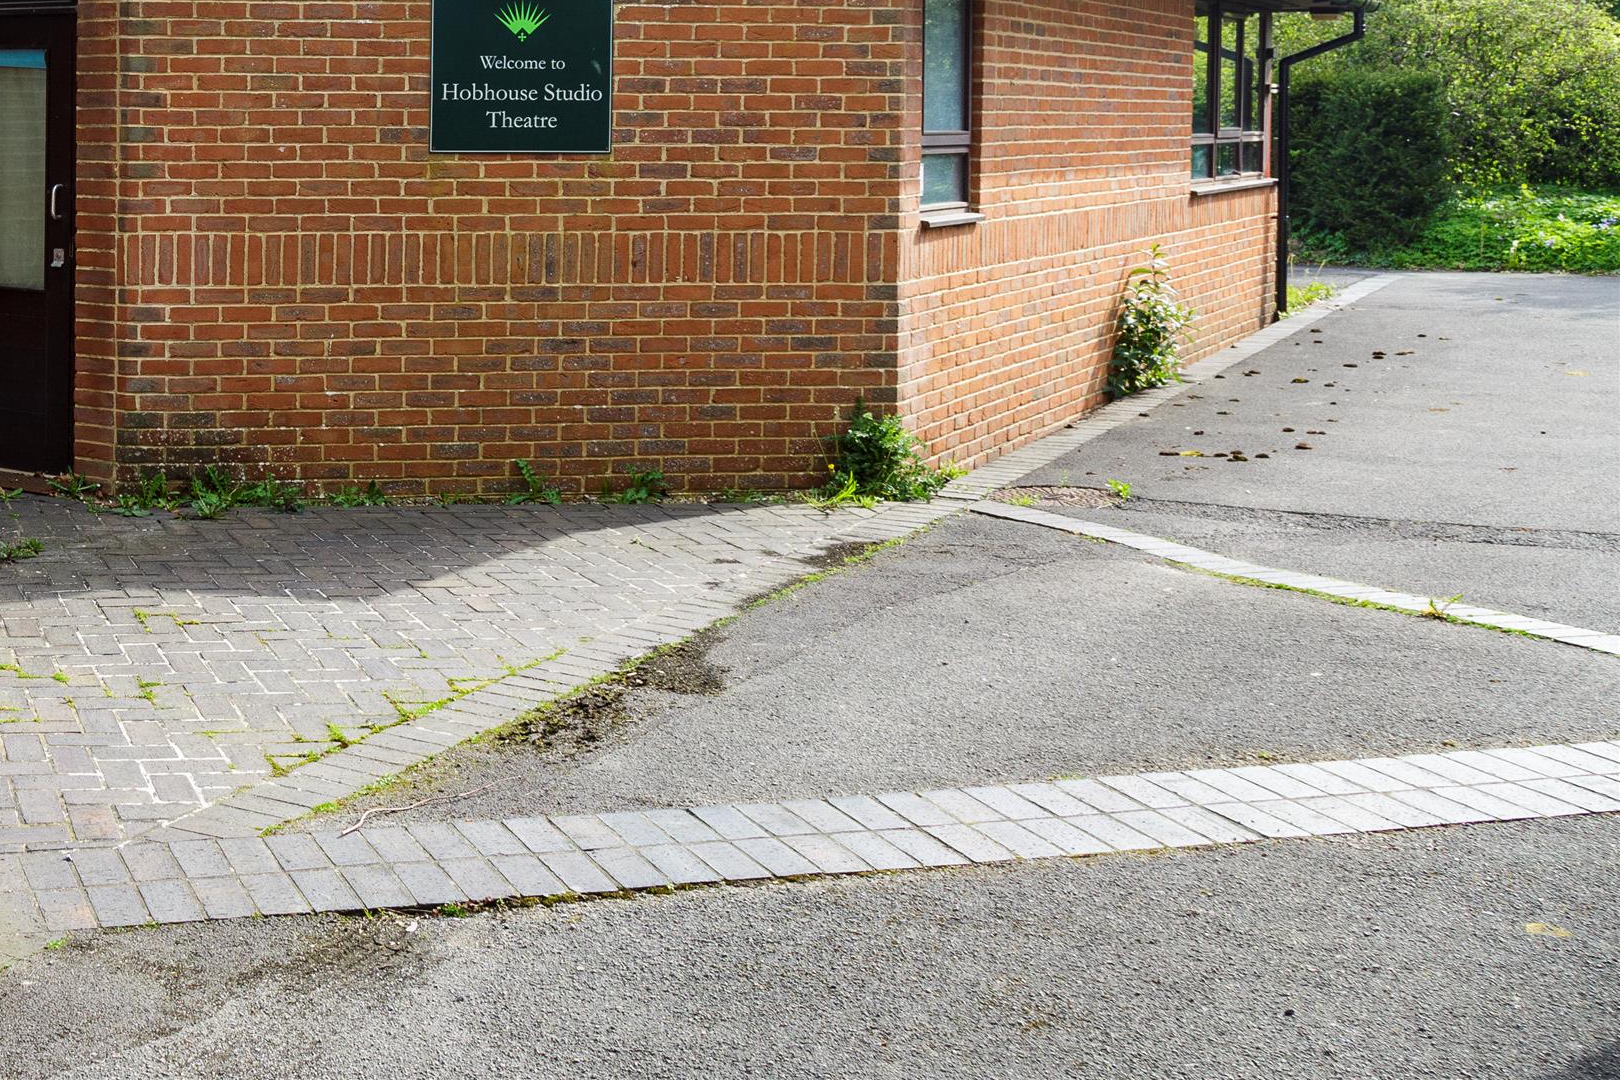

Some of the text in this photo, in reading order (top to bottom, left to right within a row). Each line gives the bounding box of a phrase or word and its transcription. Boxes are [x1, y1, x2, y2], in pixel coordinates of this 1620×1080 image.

[480, 55, 566, 70] Welcome to
[441, 83, 603, 101] Hobhouse Studio
[485, 110, 558, 128] Theatre
